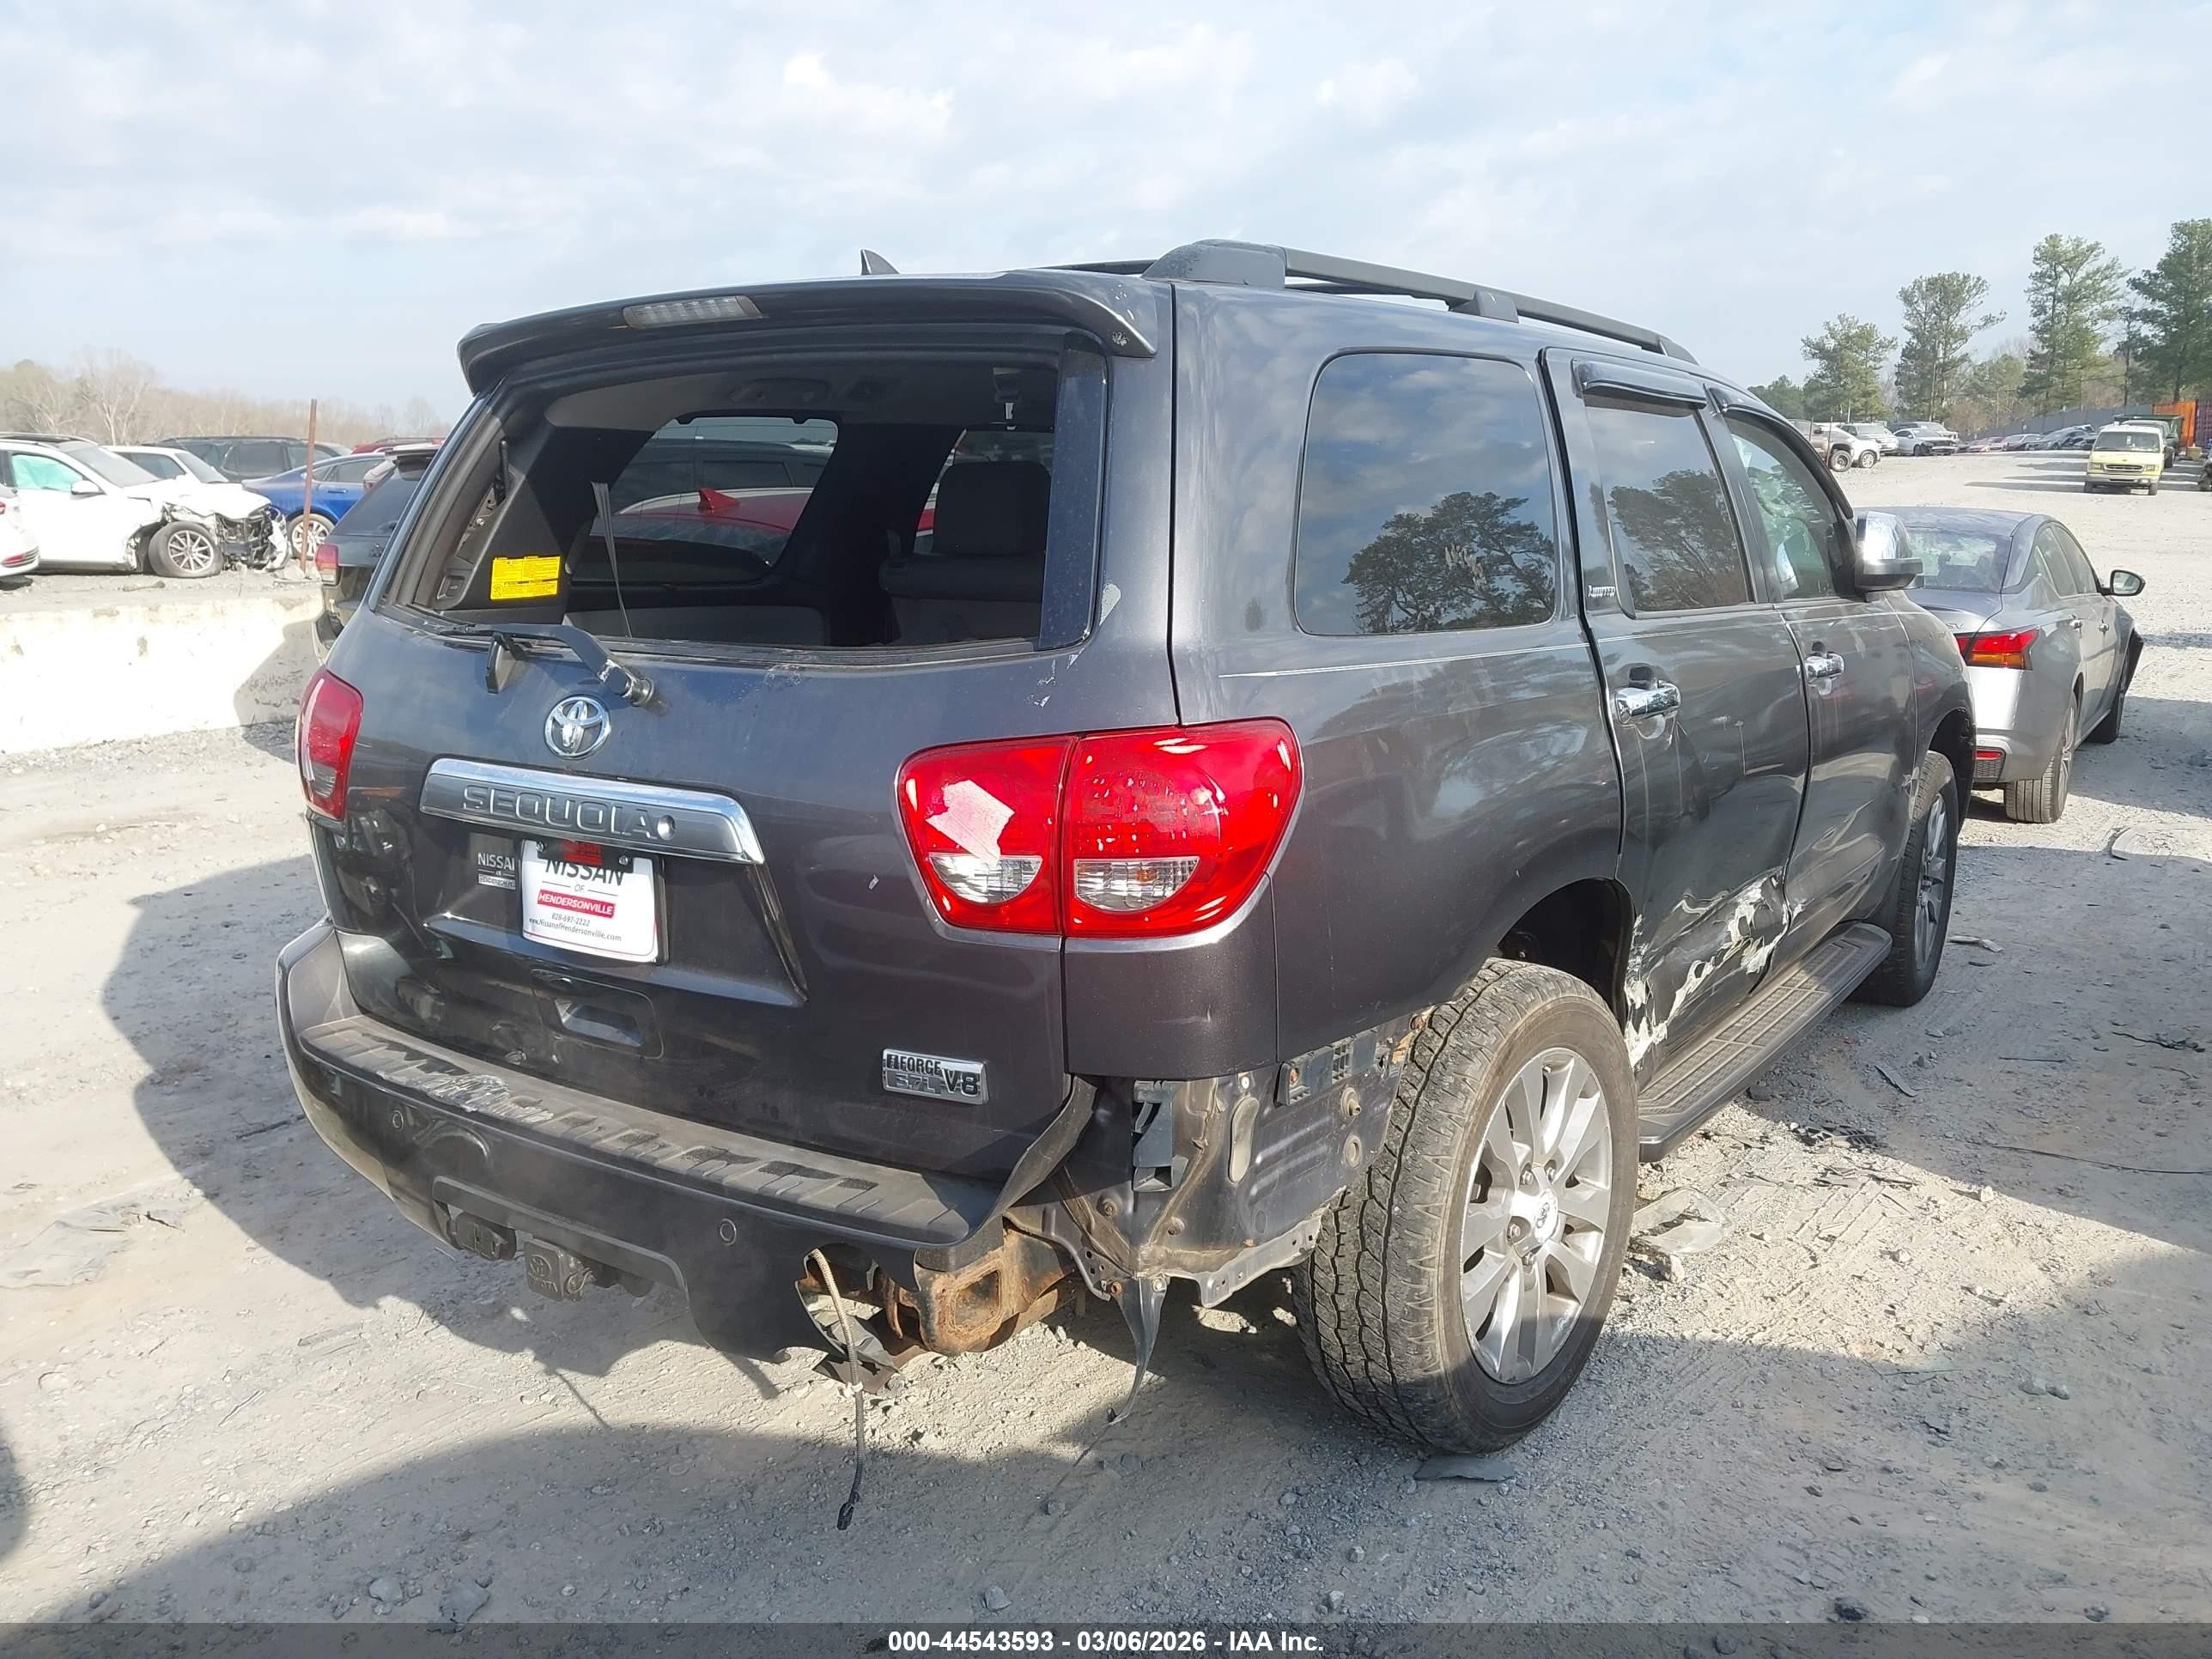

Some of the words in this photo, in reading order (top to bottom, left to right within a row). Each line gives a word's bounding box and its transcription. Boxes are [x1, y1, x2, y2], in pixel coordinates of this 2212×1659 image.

[463, 784, 659, 841] SEQUOIA
[574, 884, 586, 892] OF
[538, 891, 614, 915] HENDERSONVILLE
[529, 917, 623, 942] www.NissanofHendersonville.com
[551, 913, 591, 927] 828-697-2222
[895, 1073, 936, 1093] 5.7L
[941, 1068, 981, 1097] V8
